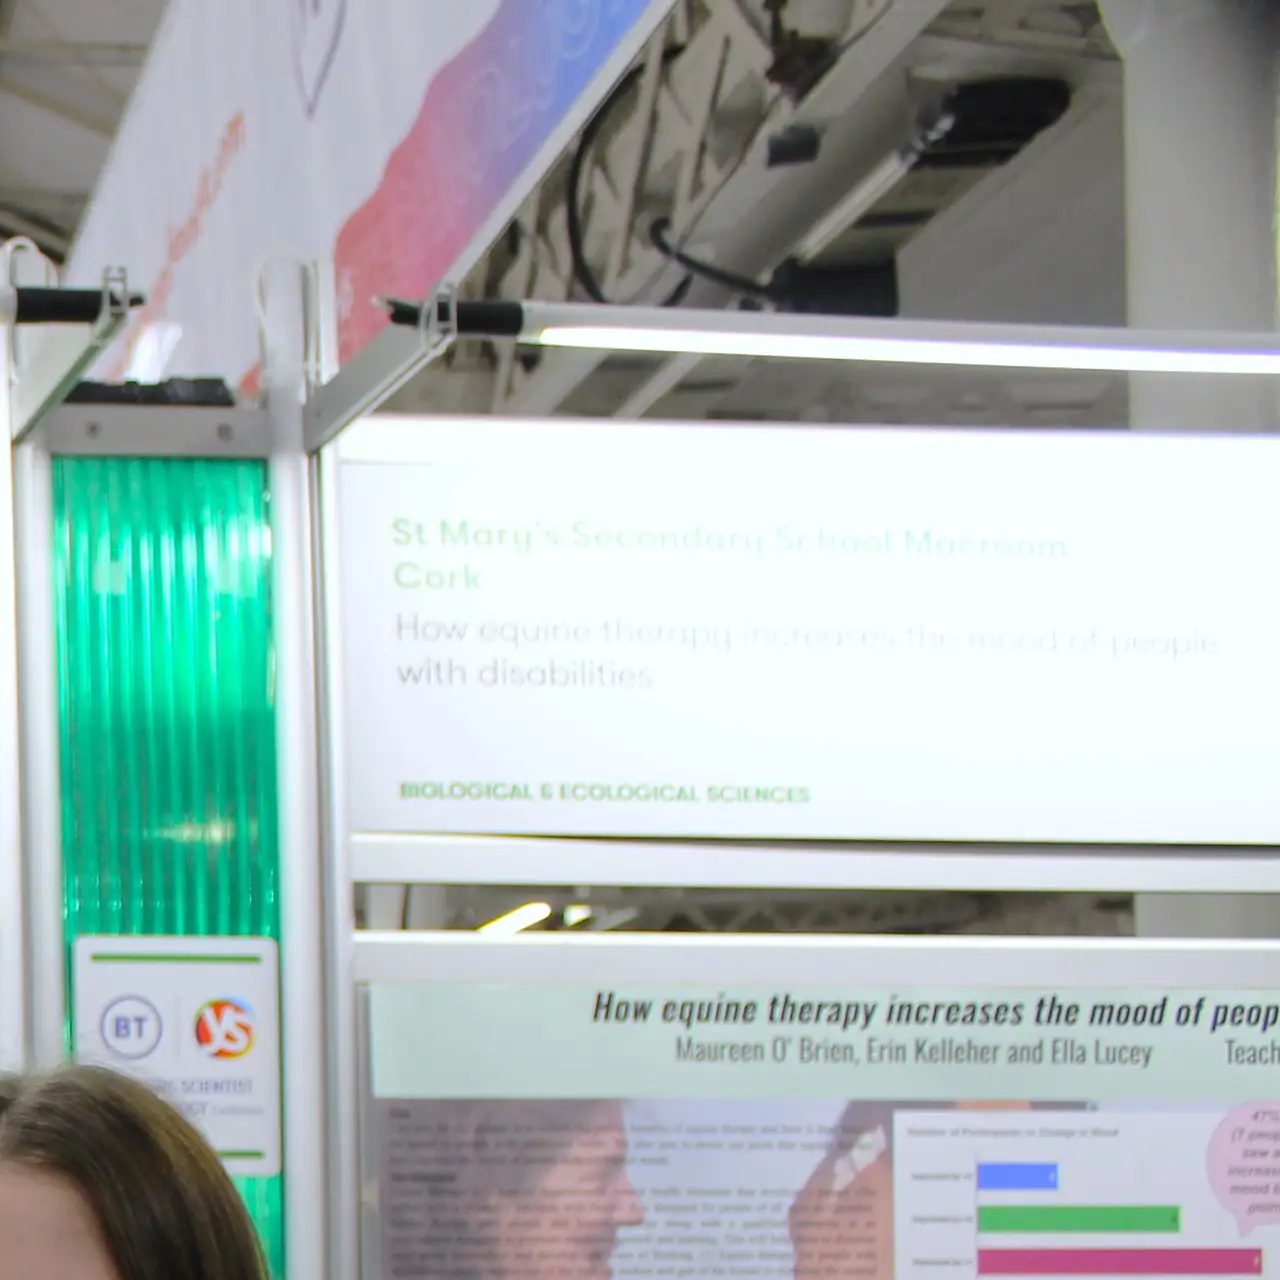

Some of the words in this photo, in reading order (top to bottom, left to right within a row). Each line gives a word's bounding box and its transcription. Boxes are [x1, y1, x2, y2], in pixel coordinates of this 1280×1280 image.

[391, 517, 427, 547] St
[439, 518, 560, 554] Mary's
[571, 520, 764, 557] Secondary
[775, 524, 893, 556] School
[904, 528, 1069, 559] Macroom
[393, 561, 483, 591] Cork
[396, 612, 468, 644] How
[480, 616, 591, 649] equine
[602, 616, 732, 652] therapy
[743, 624, 895, 652] increases
[905, 624, 959, 651] the
[968, 627, 1058, 652] mood
[1069, 626, 1100, 653] of
[1111, 628, 1220, 662] people
[397, 656, 467, 687] with
[478, 656, 654, 690] disabilities
[399, 780, 532, 801] BIOLOGICAL
[559, 782, 699, 803] ECOLOGICAL
[707, 783, 811, 804] SCIENCES
[592, 991, 653, 1024] How
[661, 993, 759, 1028] equine
[767, 994, 878, 1031] therapy
[885, 995, 1025, 1027] increases
[1034, 994, 1081, 1026] the
[1088, 996, 1169, 1027] mood
[1175, 997, 1207, 1026] of
[114, 1016, 149, 1040] BT
[675, 1036, 765, 1063] Maureen
[799, 1037, 860, 1066] Brien,
[867, 1038, 908, 1064] Erin
[914, 1038, 1001, 1065] Kelleher
[1007, 1039, 1043, 1065] and
[1051, 1039, 1087, 1065] Ella
[1094, 1040, 1154, 1069] Lucey
